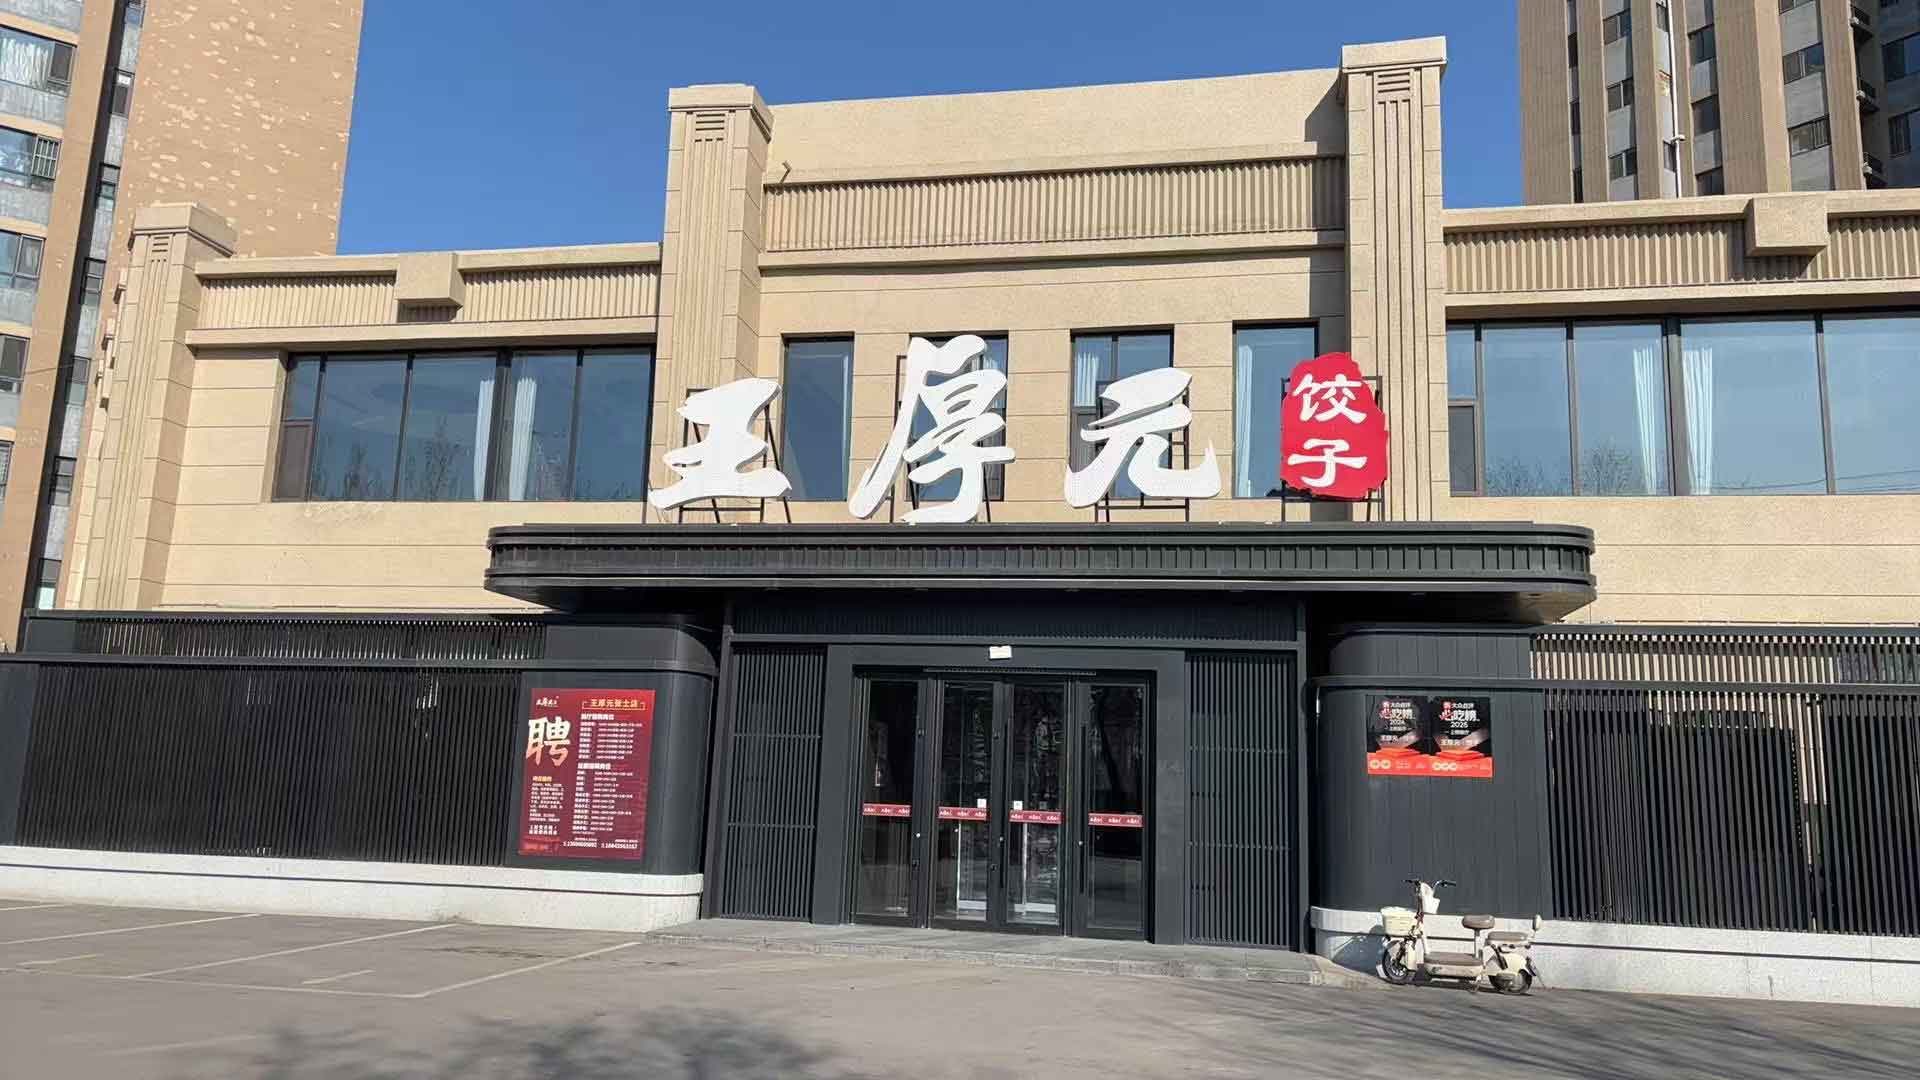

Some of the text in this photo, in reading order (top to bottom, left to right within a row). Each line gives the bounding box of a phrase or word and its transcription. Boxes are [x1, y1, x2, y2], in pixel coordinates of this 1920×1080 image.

[648, 335, 1221, 523] 王厚元
[1288, 372, 1368, 489] 饺子
[526, 716, 571, 766] 聘
